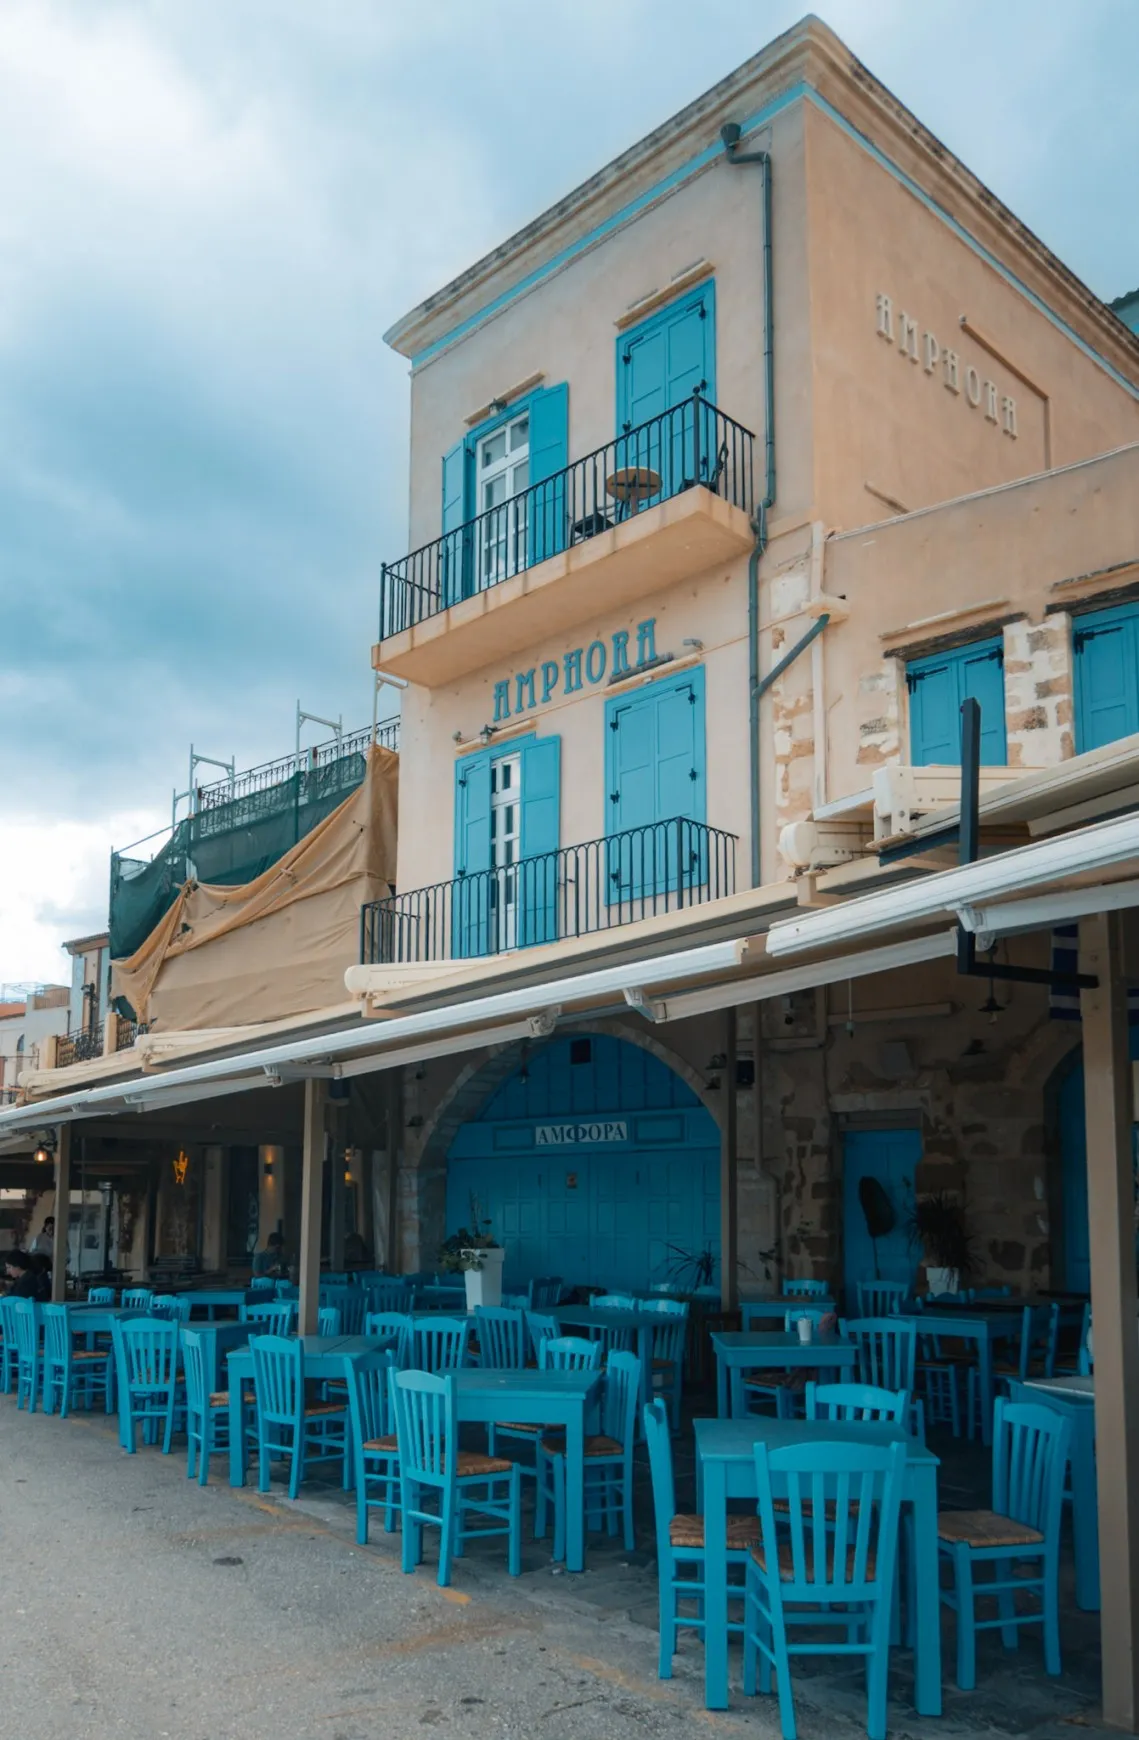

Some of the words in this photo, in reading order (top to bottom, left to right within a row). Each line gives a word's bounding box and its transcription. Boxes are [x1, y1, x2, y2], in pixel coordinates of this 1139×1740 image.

[876, 293, 1018, 440] AMPHORA
[493, 617, 658, 722] AMPHORA
[538, 1123, 625, 1144] ΑΜΦΟΡΑ
